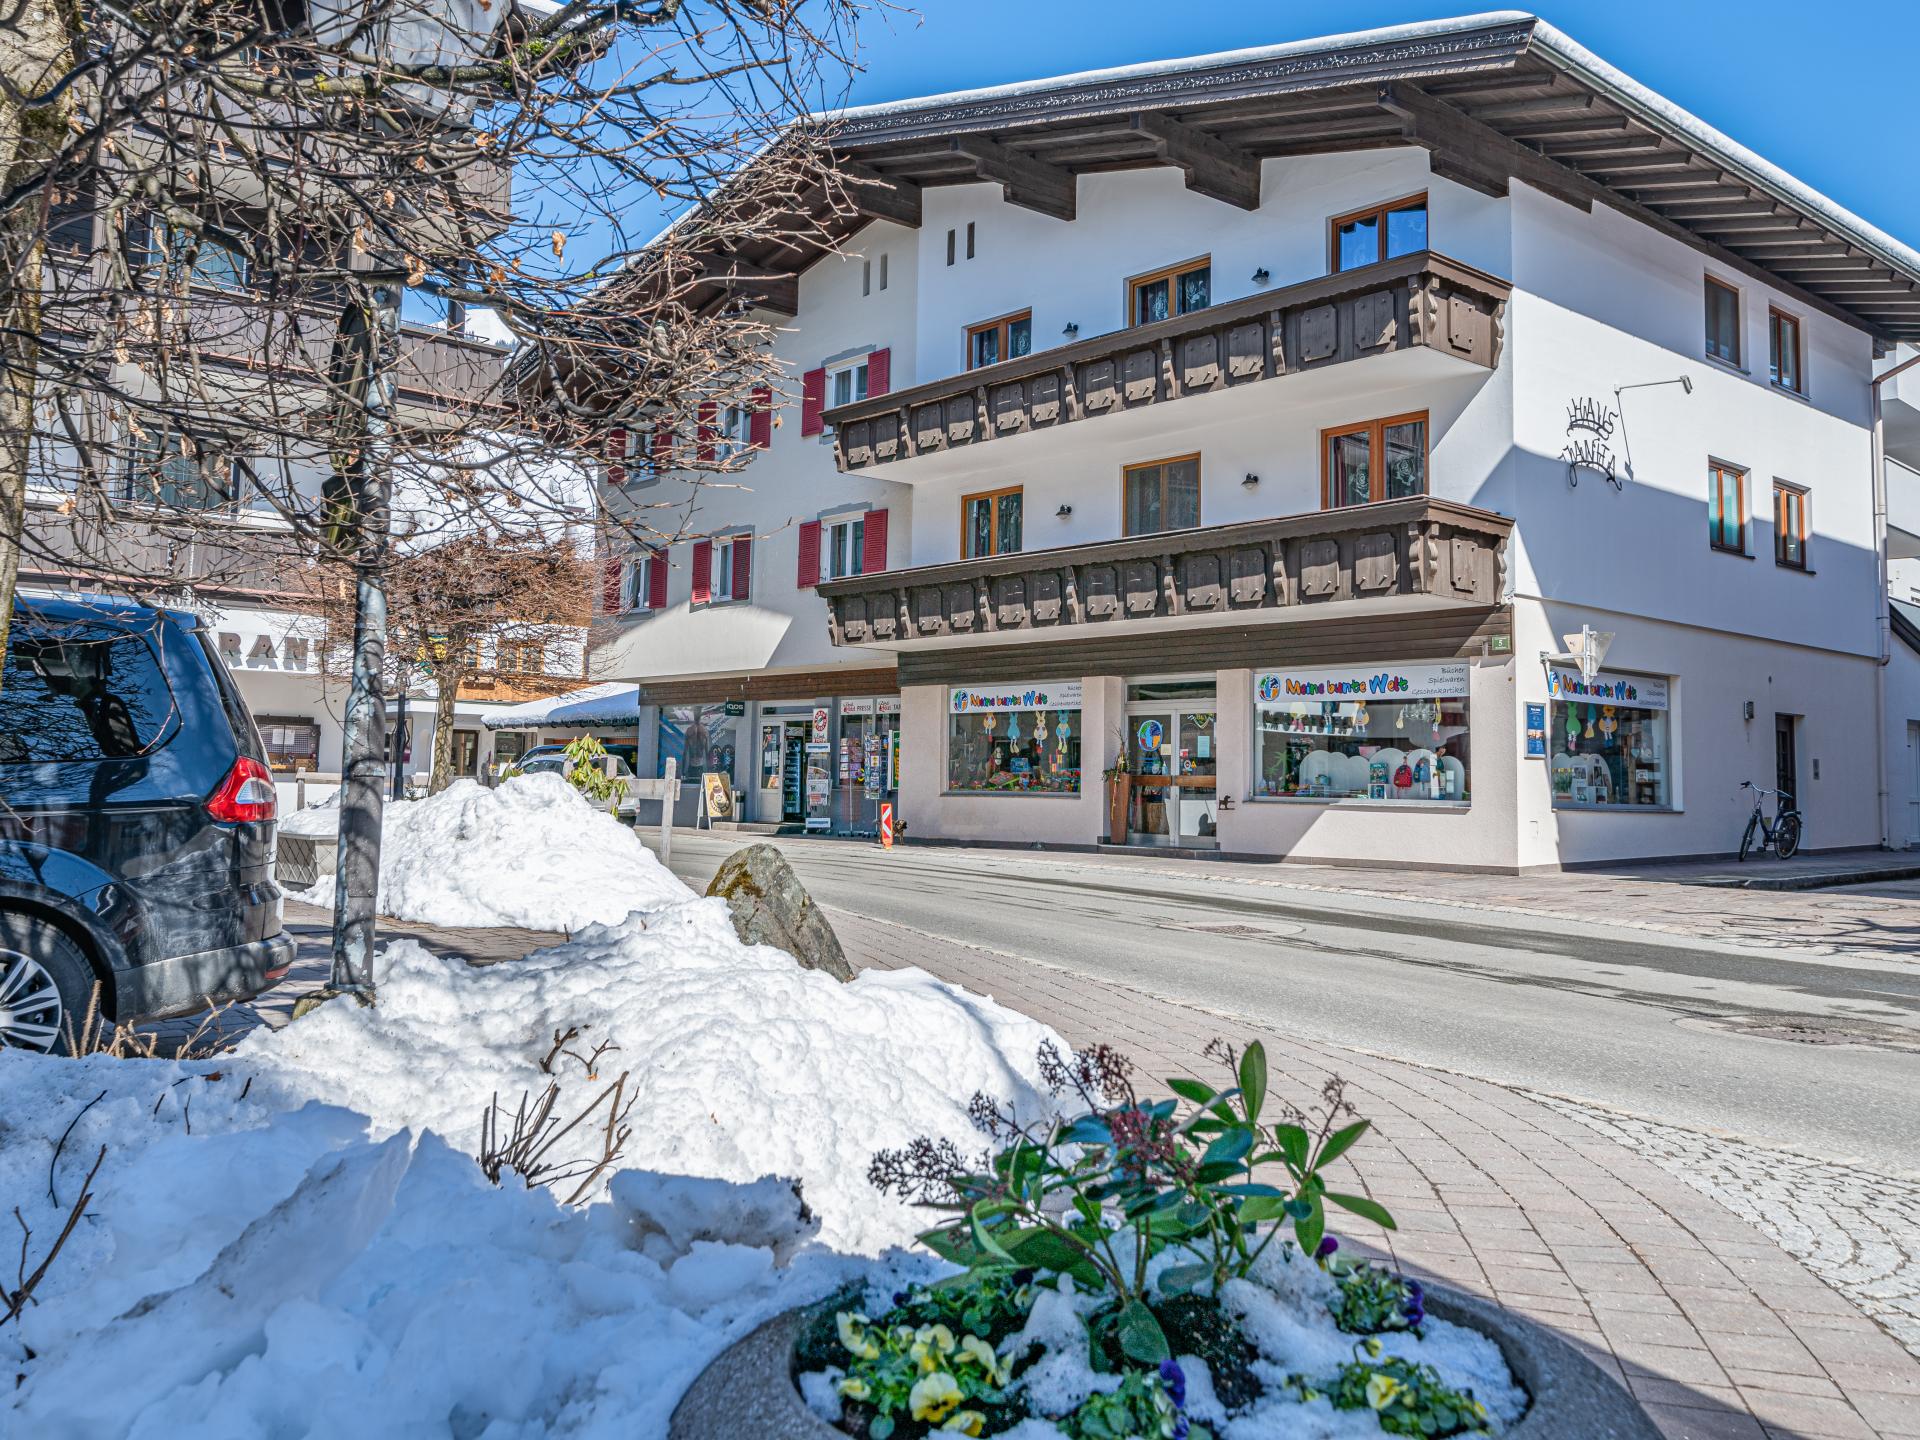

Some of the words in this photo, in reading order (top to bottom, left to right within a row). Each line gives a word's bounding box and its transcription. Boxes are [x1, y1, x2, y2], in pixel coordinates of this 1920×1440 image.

[1570, 396, 1619, 434] HAUS
[1441, 666, 1465, 674] Bücher
[1285, 678, 1325, 696] Meine
[1326, 678, 1366, 694] bunte
[1369, 673, 1409, 695] Welt
[1614, 680, 1638, 700] Welt
[969, 692, 996, 707] Meine
[996, 694, 1022, 706] bunte
[1022, 690, 1048, 706] Welt
